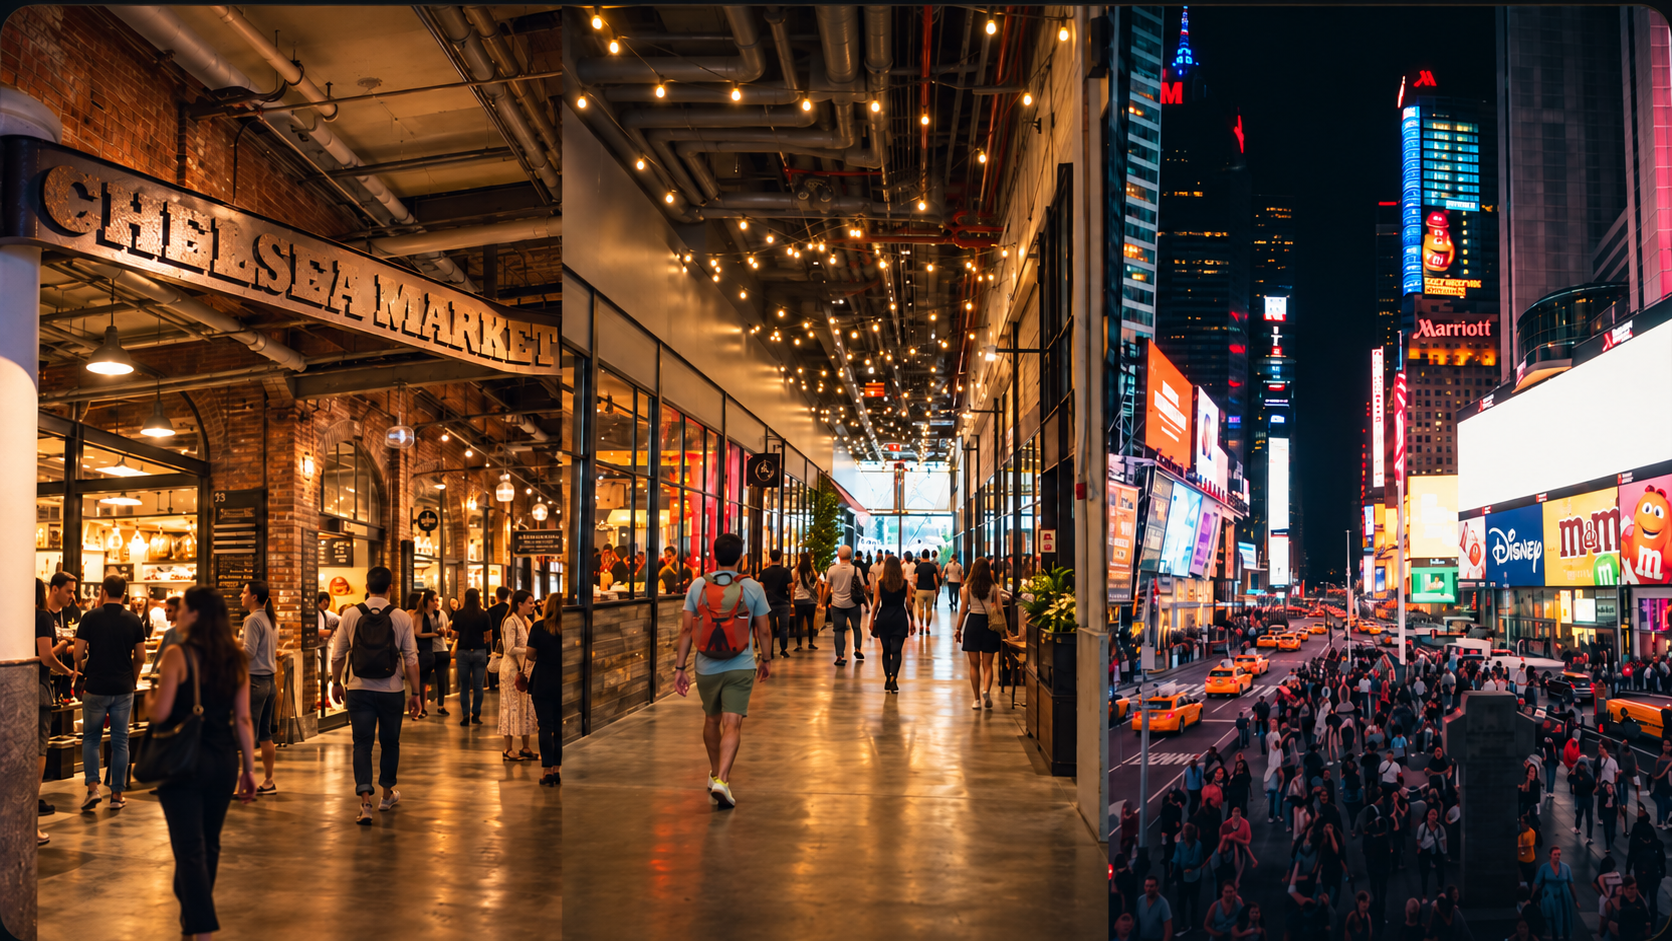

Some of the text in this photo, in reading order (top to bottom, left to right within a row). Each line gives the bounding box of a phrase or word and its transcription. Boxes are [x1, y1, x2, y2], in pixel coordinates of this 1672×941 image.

[41, 164, 559, 366] CHELSEA MARKET
[1412, 318, 1492, 340] Marriott
